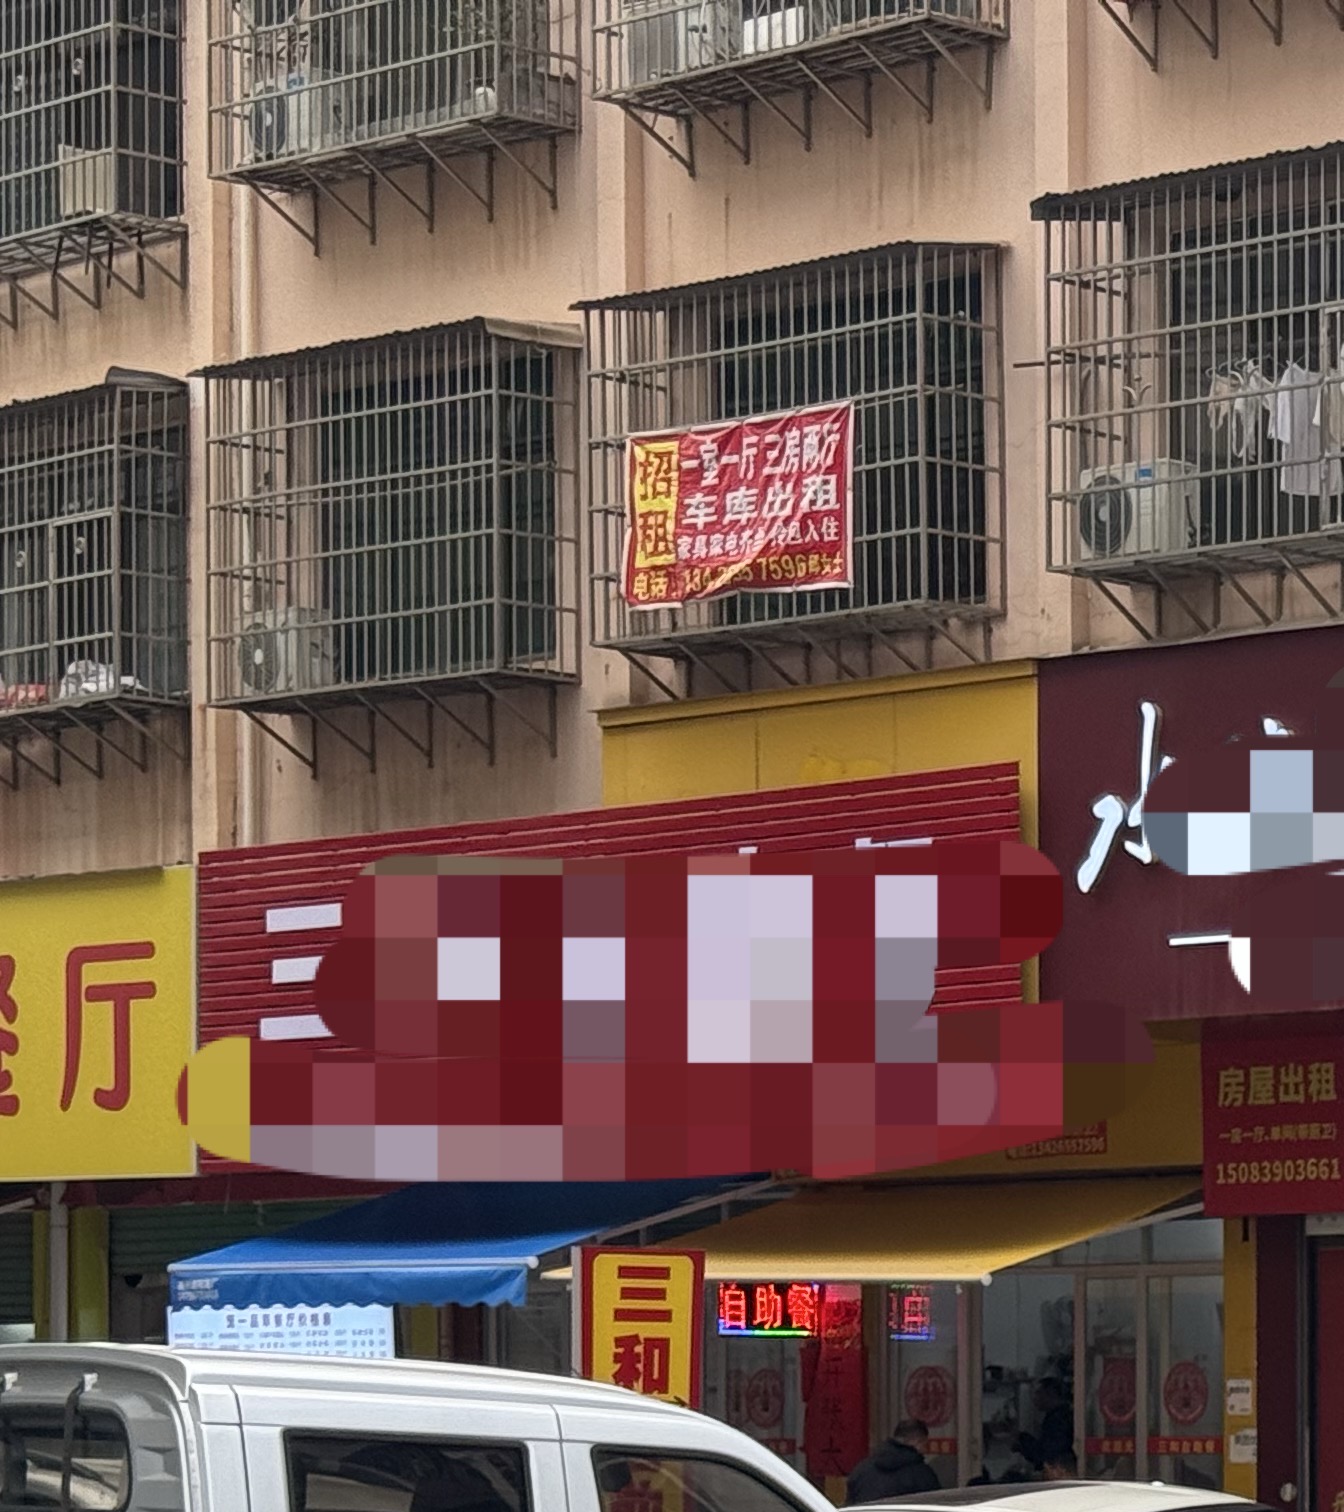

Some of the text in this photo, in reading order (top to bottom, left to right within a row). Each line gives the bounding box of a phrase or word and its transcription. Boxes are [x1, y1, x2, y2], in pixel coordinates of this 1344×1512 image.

[638, 450, 674, 560] 招租
[681, 473, 841, 530] 车库出租
[0, 941, 156, 1117] 厅
[1217, 1061, 1338, 1107] 房屋出租
[1216, 1157, 1341, 1185] 15083903661
[613, 1265, 673, 1396] 三和
[721, 1283, 816, 1330] 自助餐
